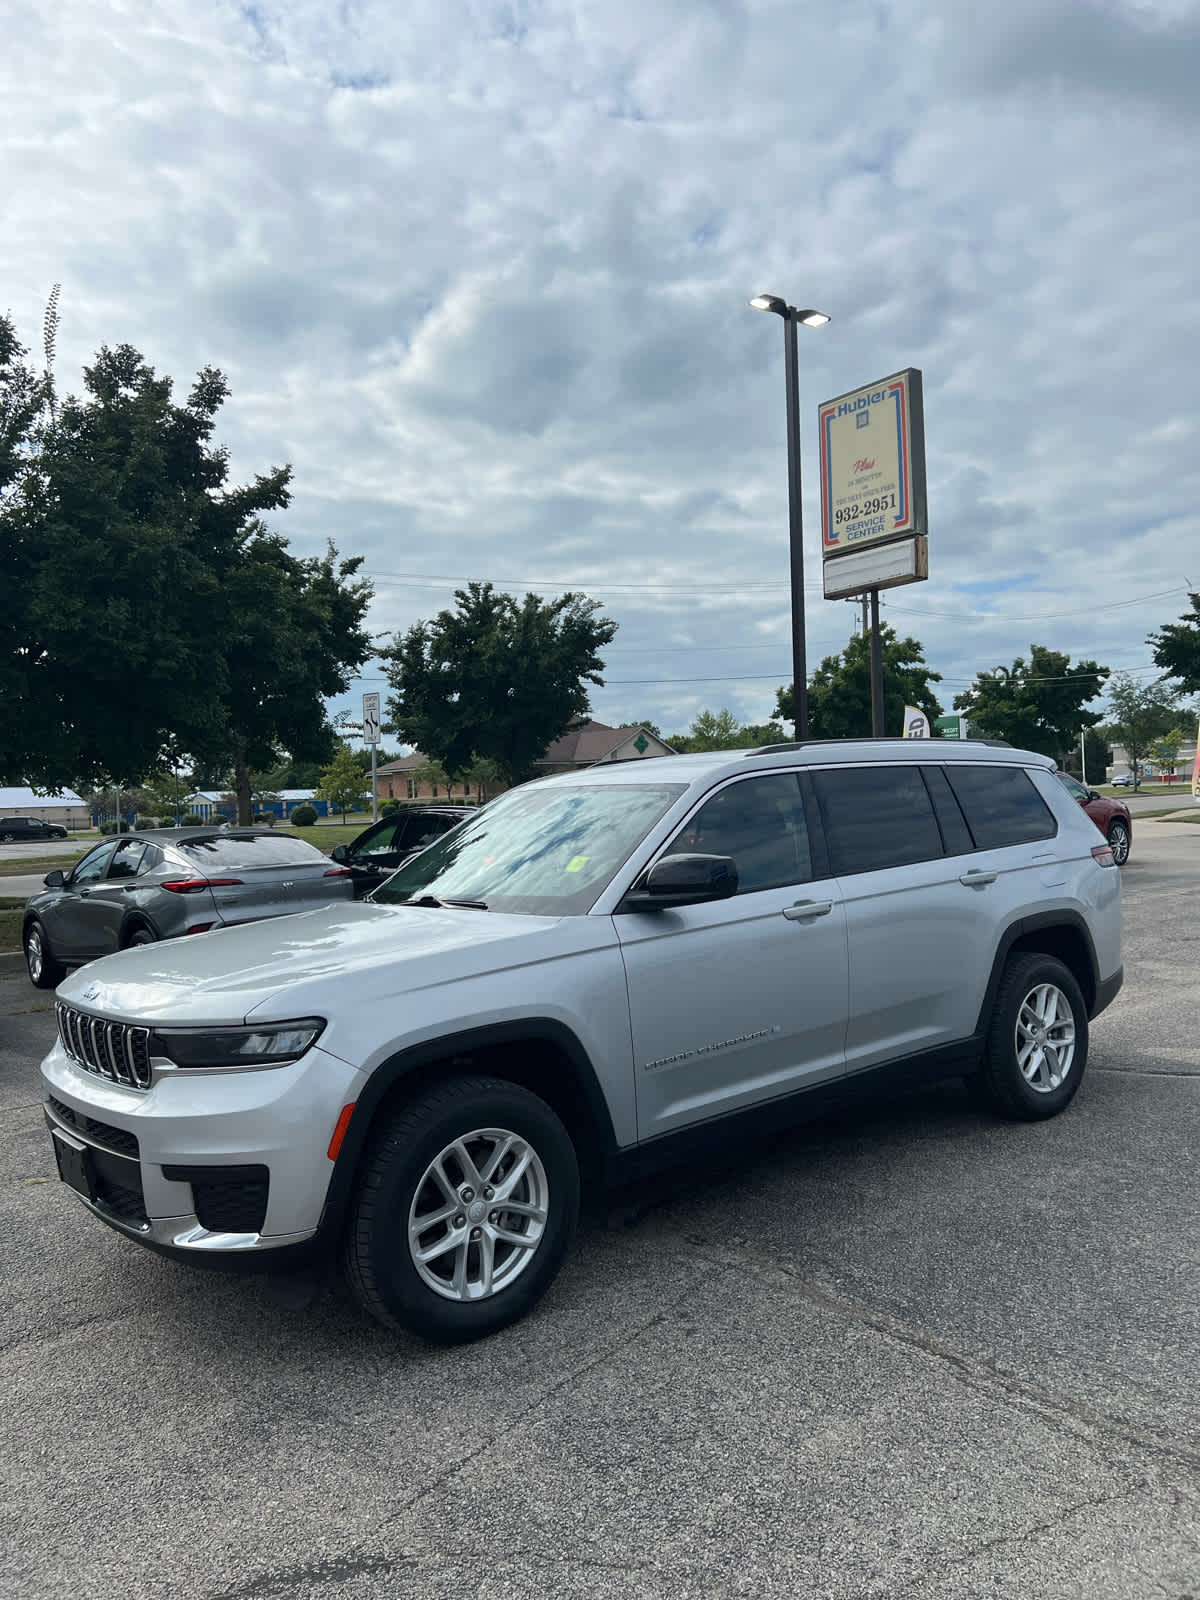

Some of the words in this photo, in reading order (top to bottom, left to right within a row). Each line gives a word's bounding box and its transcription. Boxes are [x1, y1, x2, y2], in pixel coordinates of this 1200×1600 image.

[838, 390, 887, 417] Hubler
[835, 493, 896, 524] 932-2951
[846, 516, 886, 533] SERVICE
[847, 525, 885, 541] CENTER
